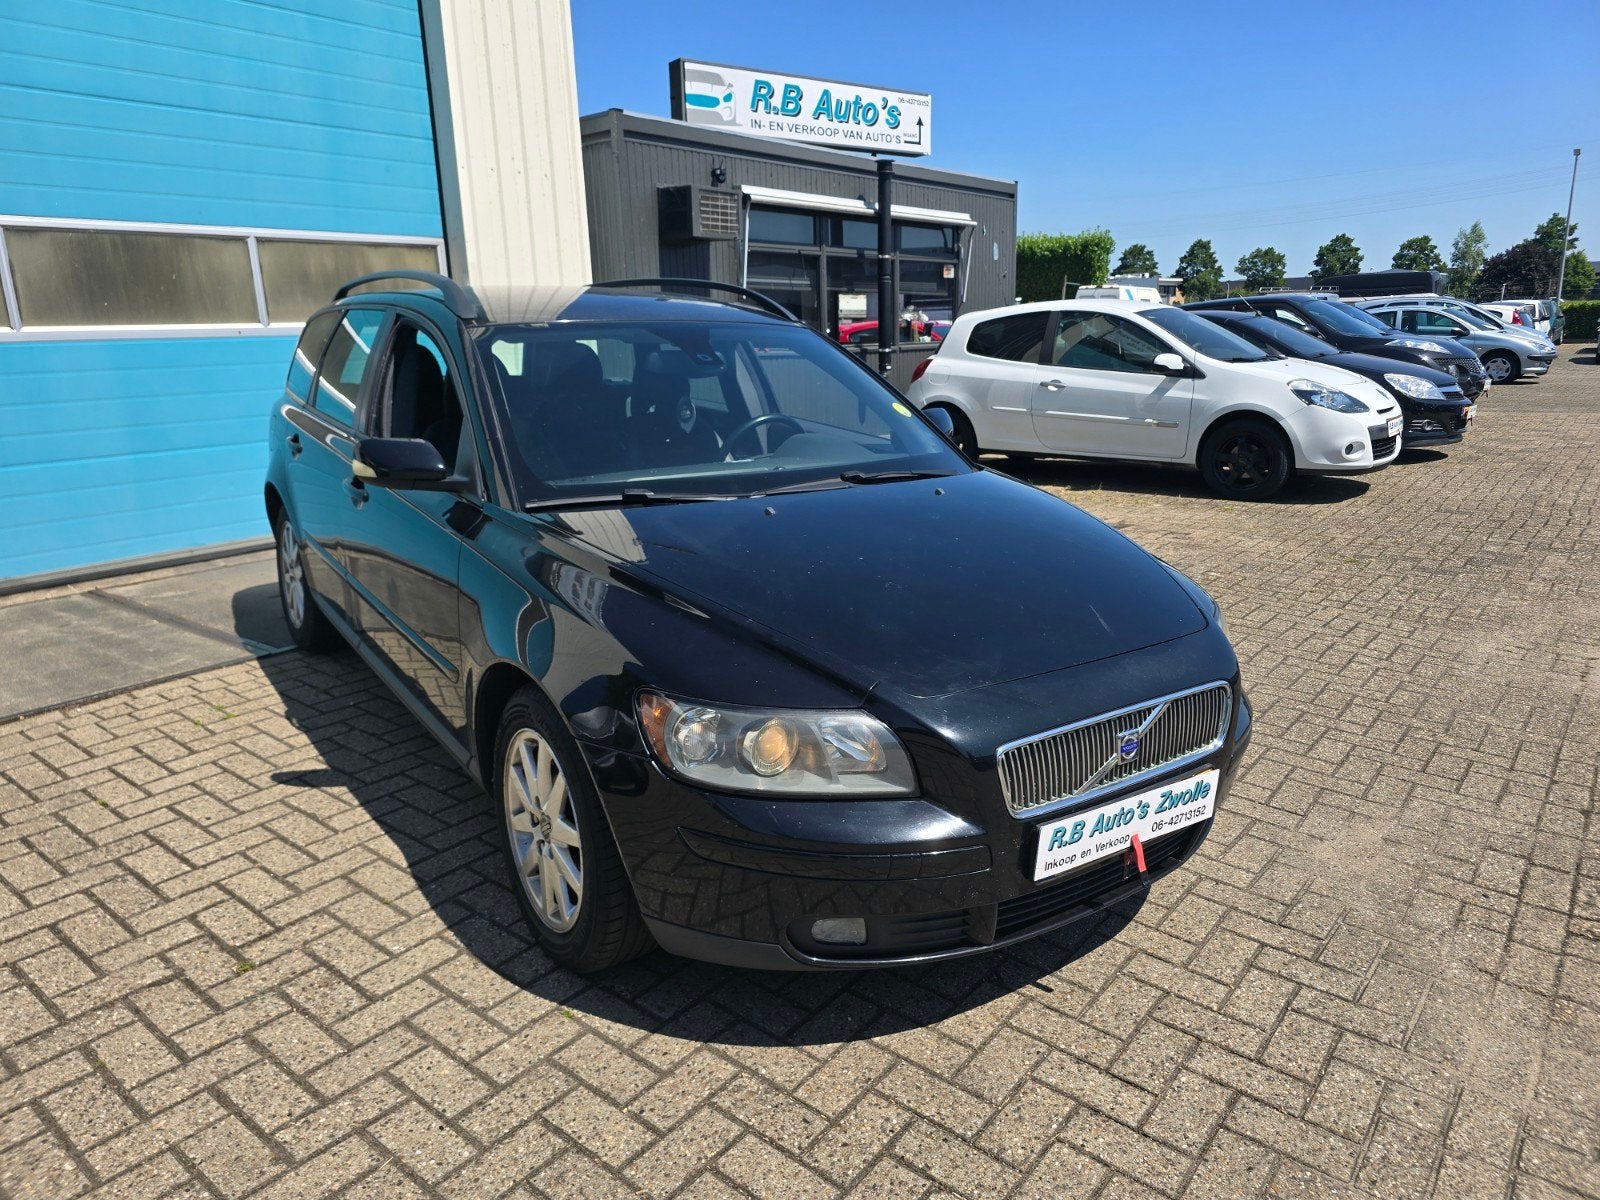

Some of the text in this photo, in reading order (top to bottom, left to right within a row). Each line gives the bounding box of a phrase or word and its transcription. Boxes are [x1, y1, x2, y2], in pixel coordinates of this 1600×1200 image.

[750, 79, 902, 129] R.B Auto's
[750, 118, 901, 144] IN- EN VERKOOP VAN AUTO'S
[1048, 779, 1211, 851] R.B Auto's Zwolle
[1151, 804, 1206, 833] 06-42713152
[1044, 834, 1130, 872] Inkoop en Verkoop
